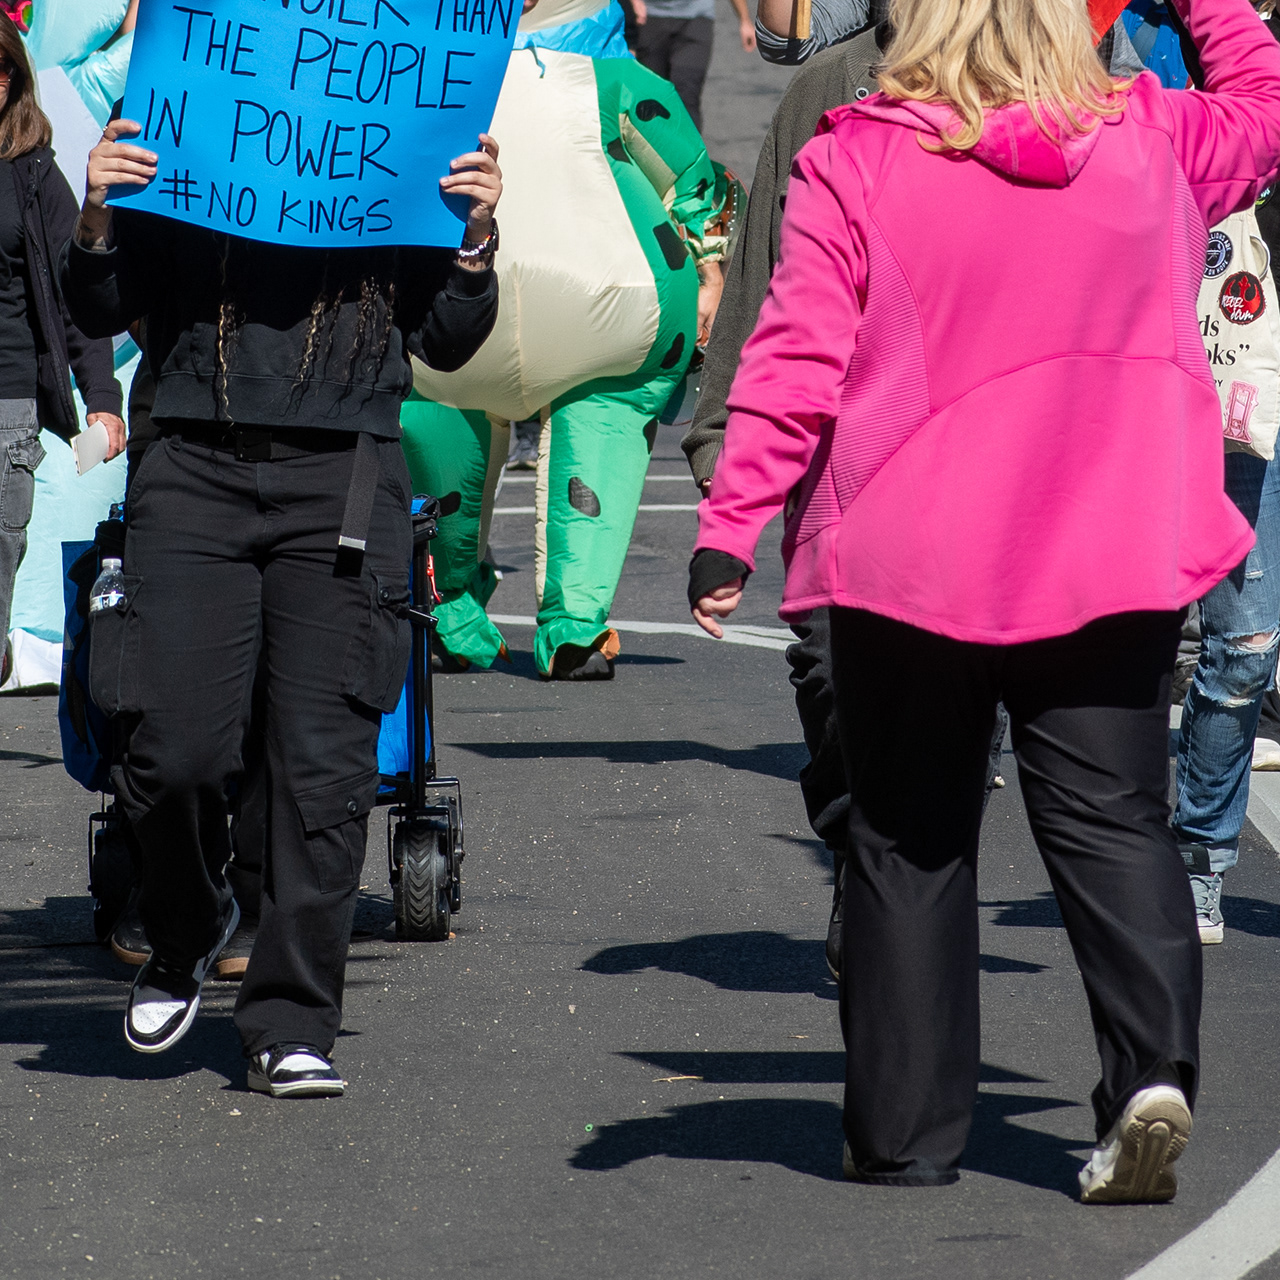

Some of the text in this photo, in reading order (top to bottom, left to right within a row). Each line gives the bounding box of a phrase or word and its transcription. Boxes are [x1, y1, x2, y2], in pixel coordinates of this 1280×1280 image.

[173, 5, 477, 110] THE PEOPLE
[142, 87, 398, 182] IN POWER
[277, 190, 393, 235] KINGS
